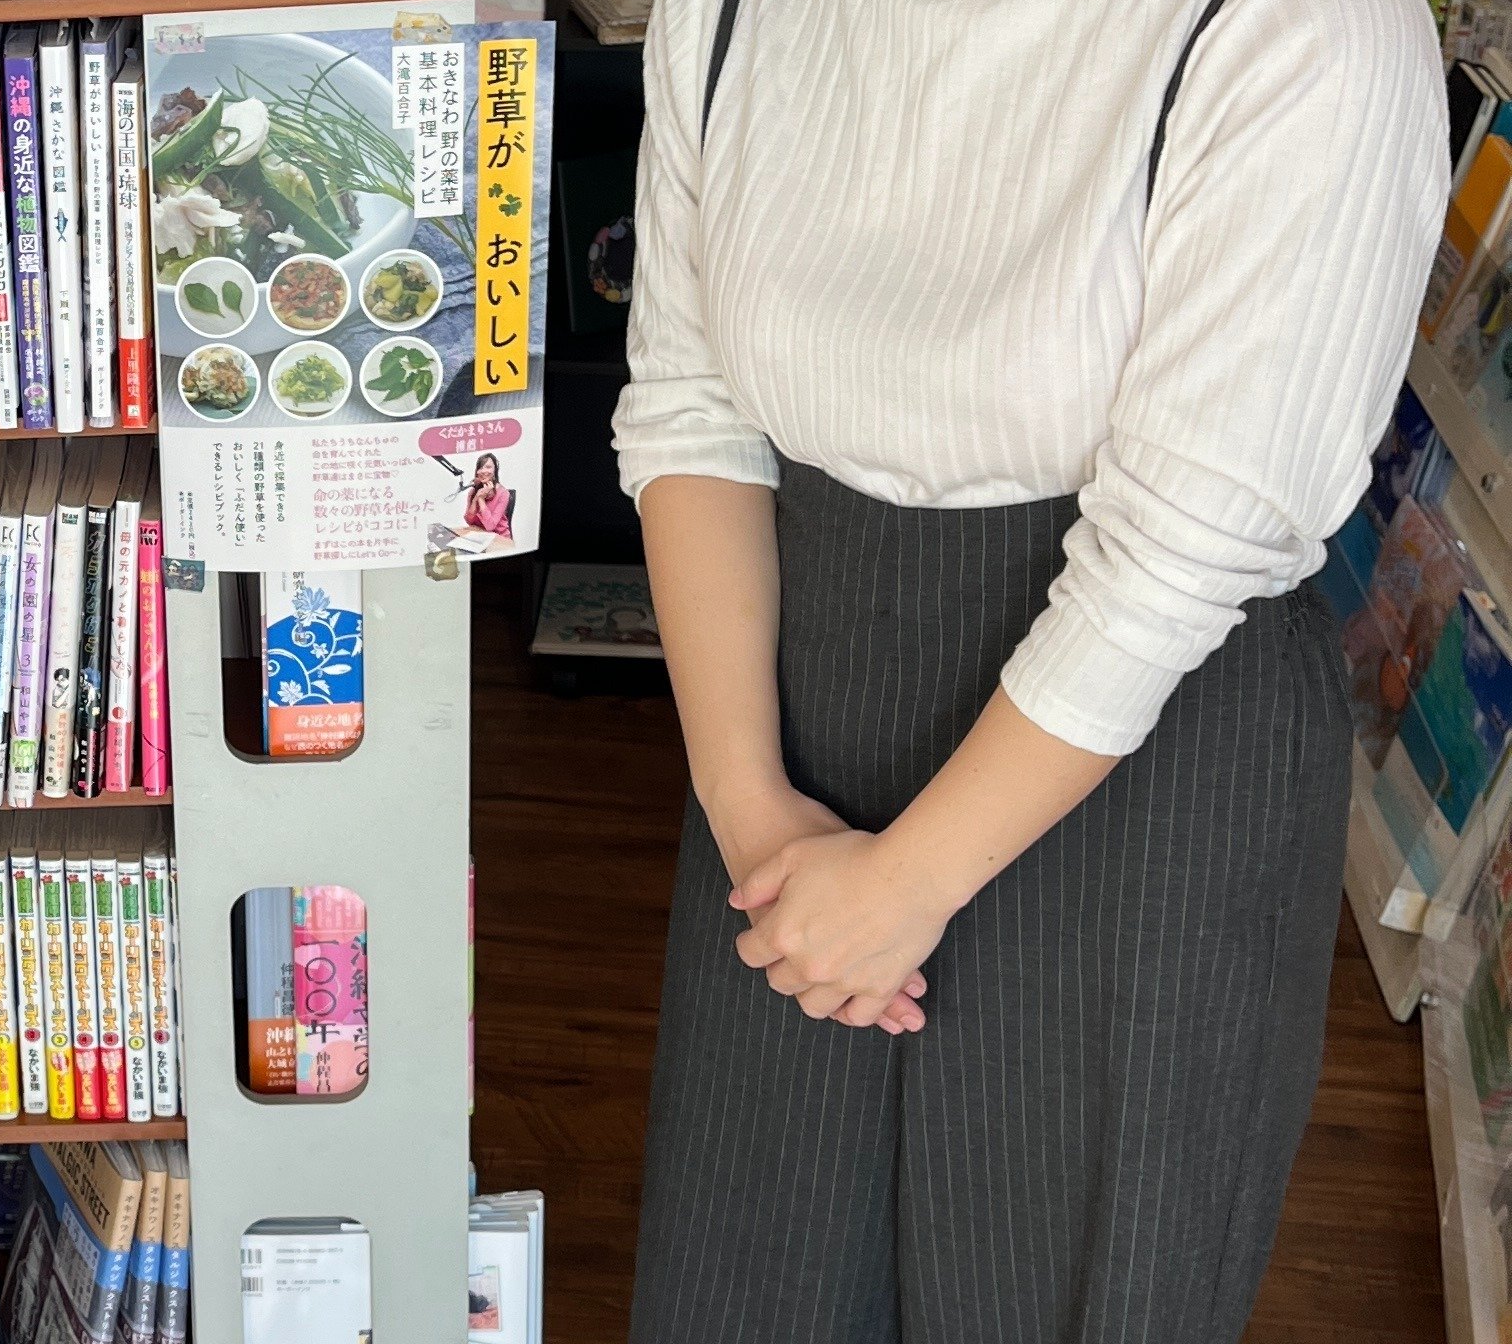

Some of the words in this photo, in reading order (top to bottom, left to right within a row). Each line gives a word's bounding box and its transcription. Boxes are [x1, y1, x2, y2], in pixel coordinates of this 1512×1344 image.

[88, 61, 103, 152] 野草がおいしい
[418, 51, 438, 205] 基本料理レシピ
[9, 75, 42, 274] 沖縄の身近な植物図鑑
[117, 99, 138, 210] 海の王国・琉球
[438, 422, 505, 440] くだかまりさん
[213, 442, 227, 537] できるレシピブック。
[233, 442, 247, 548] おいしく「ふだん使い」
[253, 442, 266, 543] 21種類の野草を使った
[274, 441, 286, 523] 身近で採集できる
[313, 485, 394, 503] 命の薬になる
[313, 499, 435, 519] 数々の野草を使った
[19, 557, 41, 644] 女の園の星
[22, 655, 31, 667] 3
[19, 686, 31, 734] 和山やま
